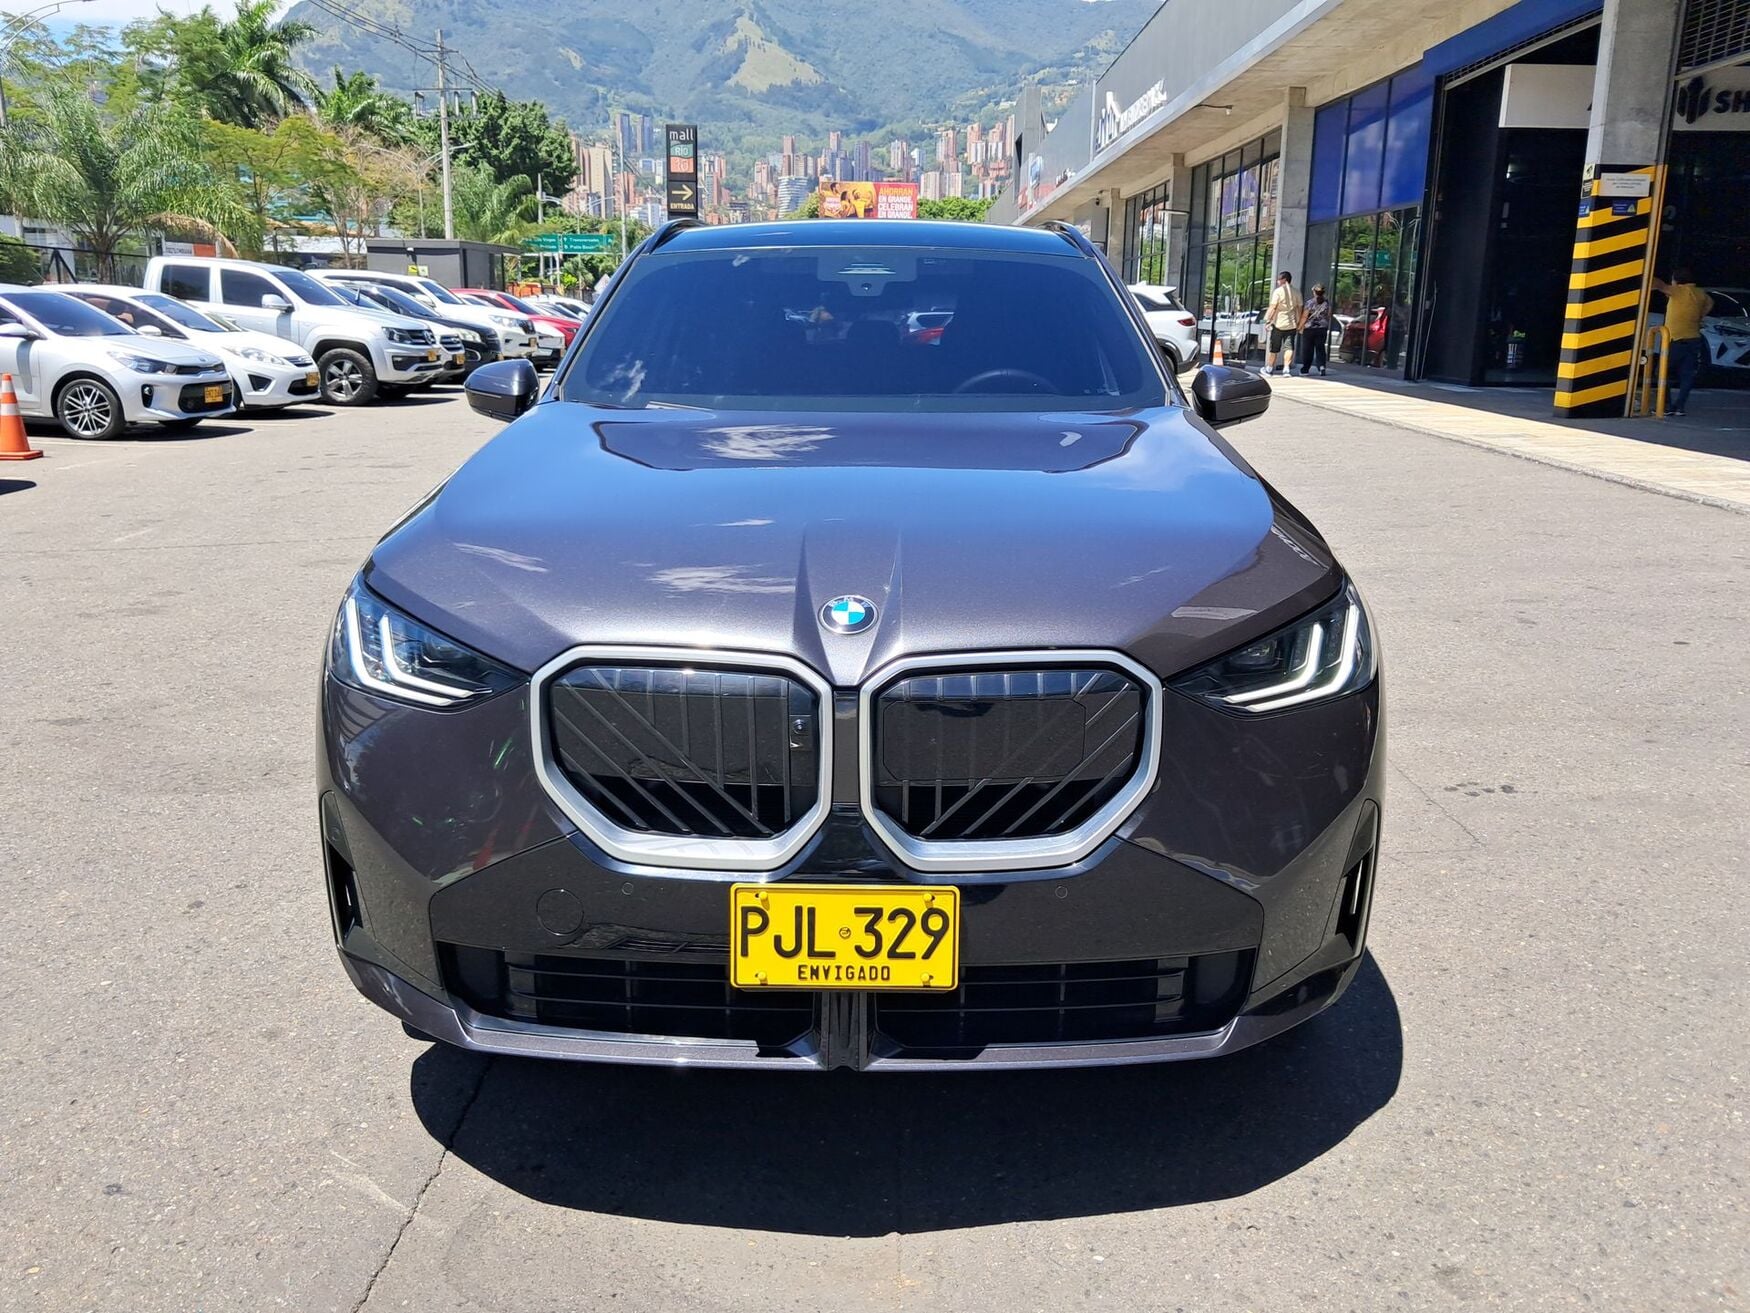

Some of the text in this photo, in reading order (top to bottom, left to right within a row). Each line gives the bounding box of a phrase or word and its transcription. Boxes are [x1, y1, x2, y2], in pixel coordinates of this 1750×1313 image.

[670, 128, 694, 140] mall
[880, 187, 913, 195] AHORRAN
[878, 195, 887, 203] EN
[878, 203, 913, 211] CELEBRAN
[741, 905, 950, 960] PJL 329
[798, 964, 891, 981] ENVIGADO
